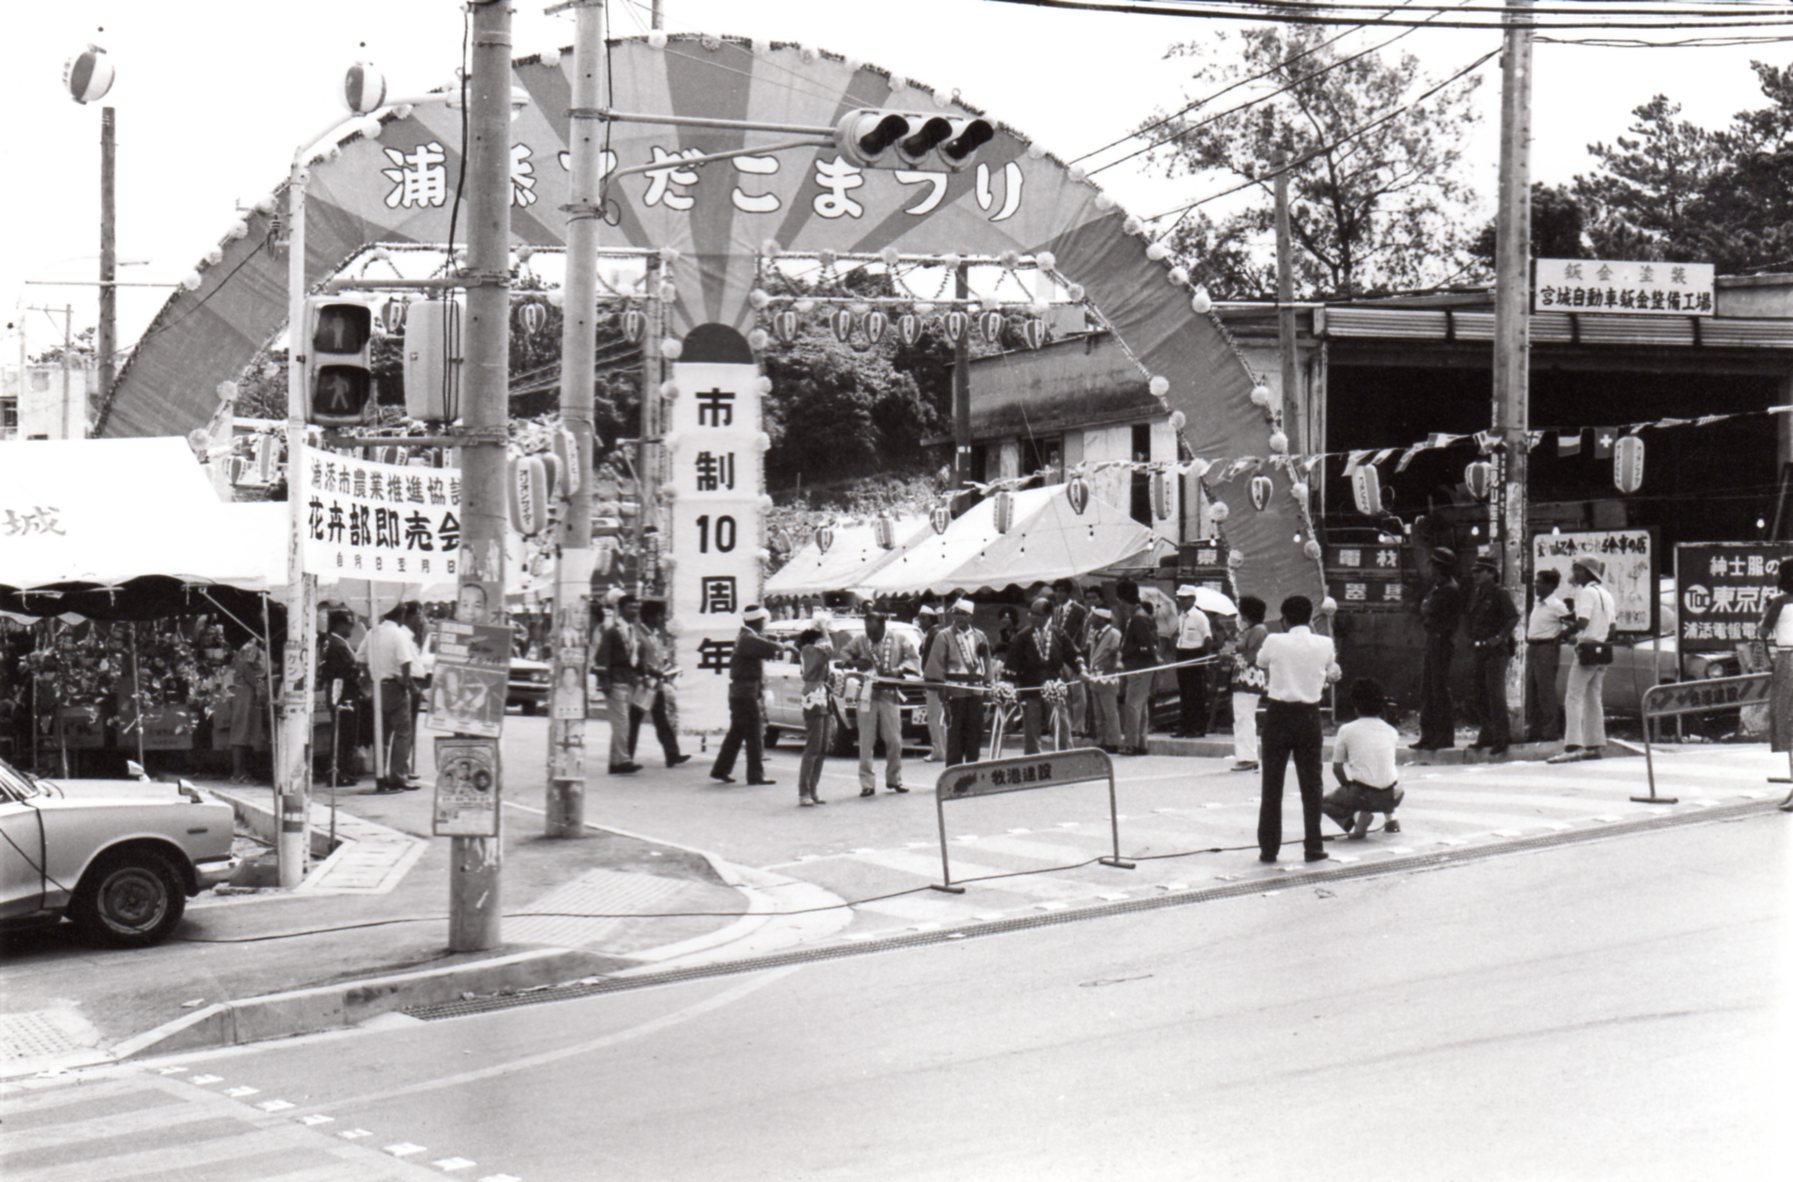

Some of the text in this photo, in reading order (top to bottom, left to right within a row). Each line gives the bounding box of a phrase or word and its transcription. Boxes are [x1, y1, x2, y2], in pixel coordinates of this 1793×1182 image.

[308, 494, 461, 553] 花卉部即売会
[694, 387, 738, 676] 市制10周年
[1709, 555, 1793, 577] 紳士服の
